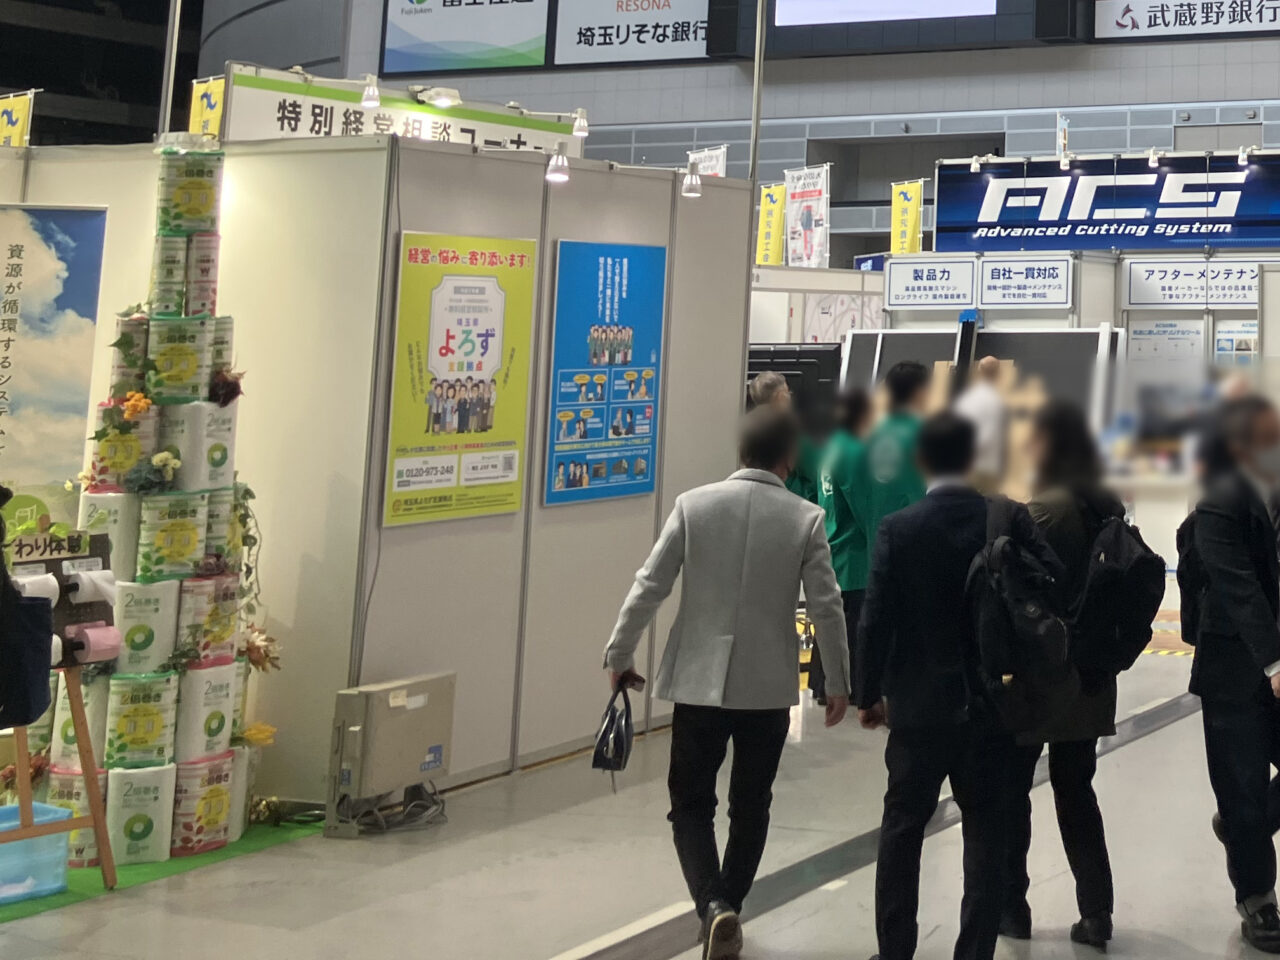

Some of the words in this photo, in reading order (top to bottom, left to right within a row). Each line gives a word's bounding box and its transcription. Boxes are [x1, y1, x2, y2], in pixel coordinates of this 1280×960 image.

[576, 20, 708, 47] 埼玉りそな銀行
[976, 170, 1249, 223] ACS
[974, 224, 1072, 238] Advanced
[1075, 223, 1150, 237] Cutting
[1154, 222, 1232, 236] System
[912, 267, 951, 281] 製品力
[990, 266, 1060, 280] 自社一貫対応
[438, 327, 496, 358] よろず
